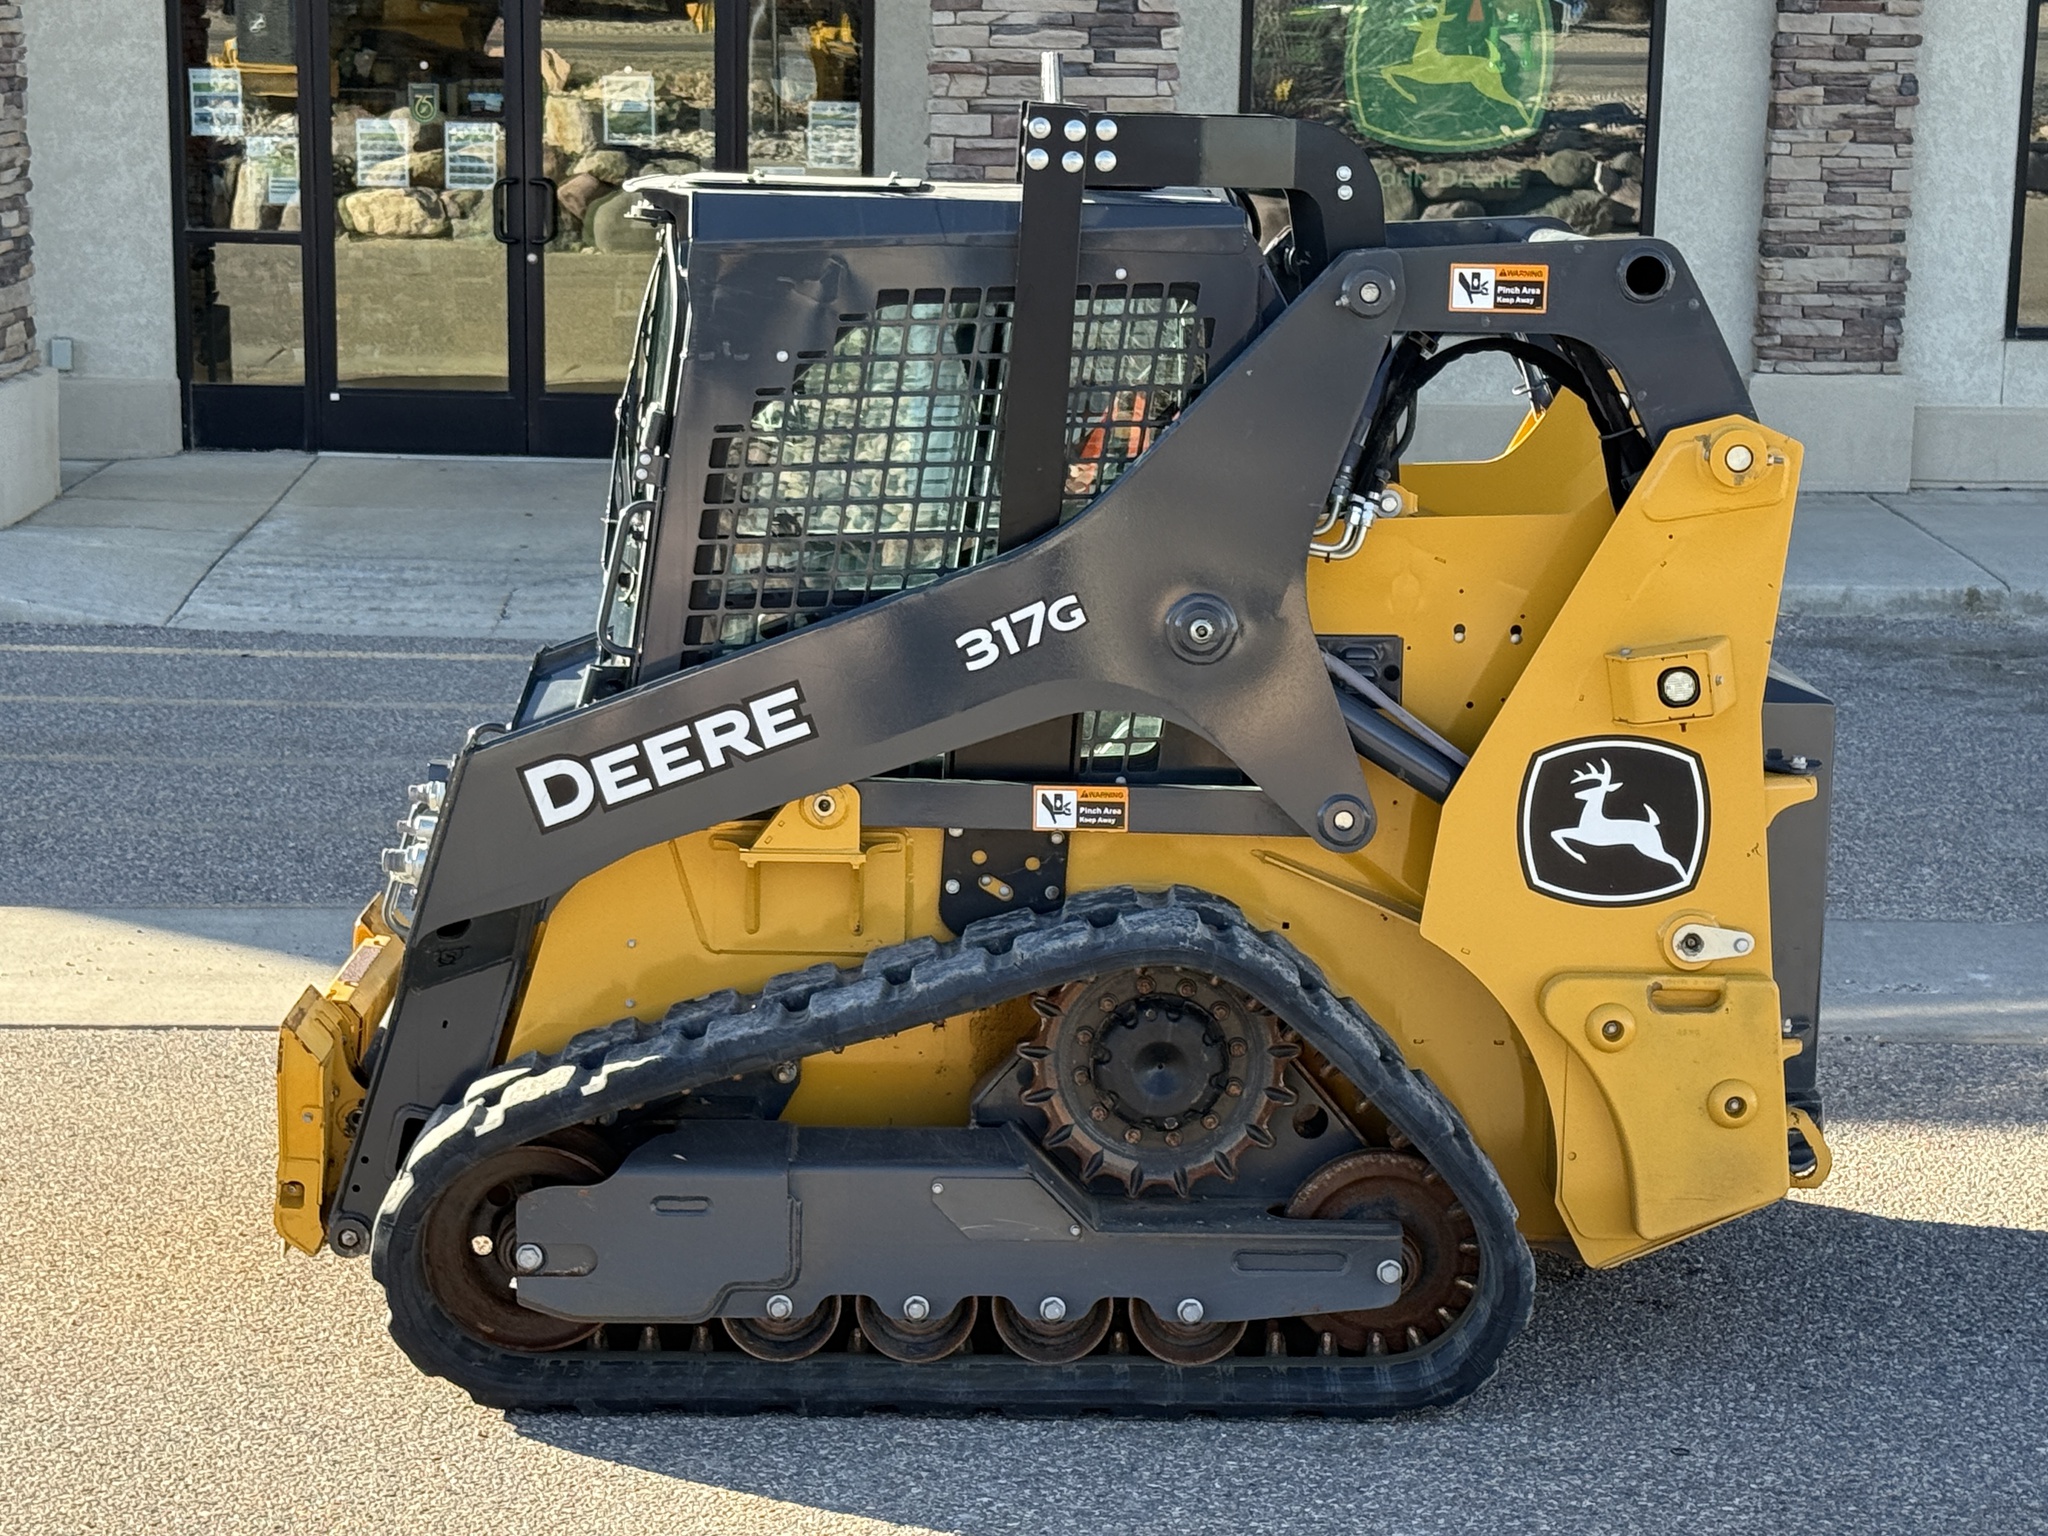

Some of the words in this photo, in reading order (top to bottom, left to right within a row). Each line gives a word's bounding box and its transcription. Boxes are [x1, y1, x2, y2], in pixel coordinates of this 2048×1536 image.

[1379, 171, 1429, 188] OHN
[1438, 168, 1522, 189] DEERE
[1507, 270, 1543, 278] WARNING
[1497, 286, 1520, 295] Pinch
[1522, 286, 1541, 295] Area
[1496, 296, 1515, 306] Keep
[1516, 297, 1535, 306] Away
[956, 595, 1087, 671] 317G
[523, 687, 811, 828] DEERE
[1088, 791, 1124, 799] WARNING
[1079, 806, 1102, 815] Pinch
[1103, 807, 1122, 815] Area
[1079, 816, 1097, 825] Keep
[1097, 817, 1116, 825] Away
